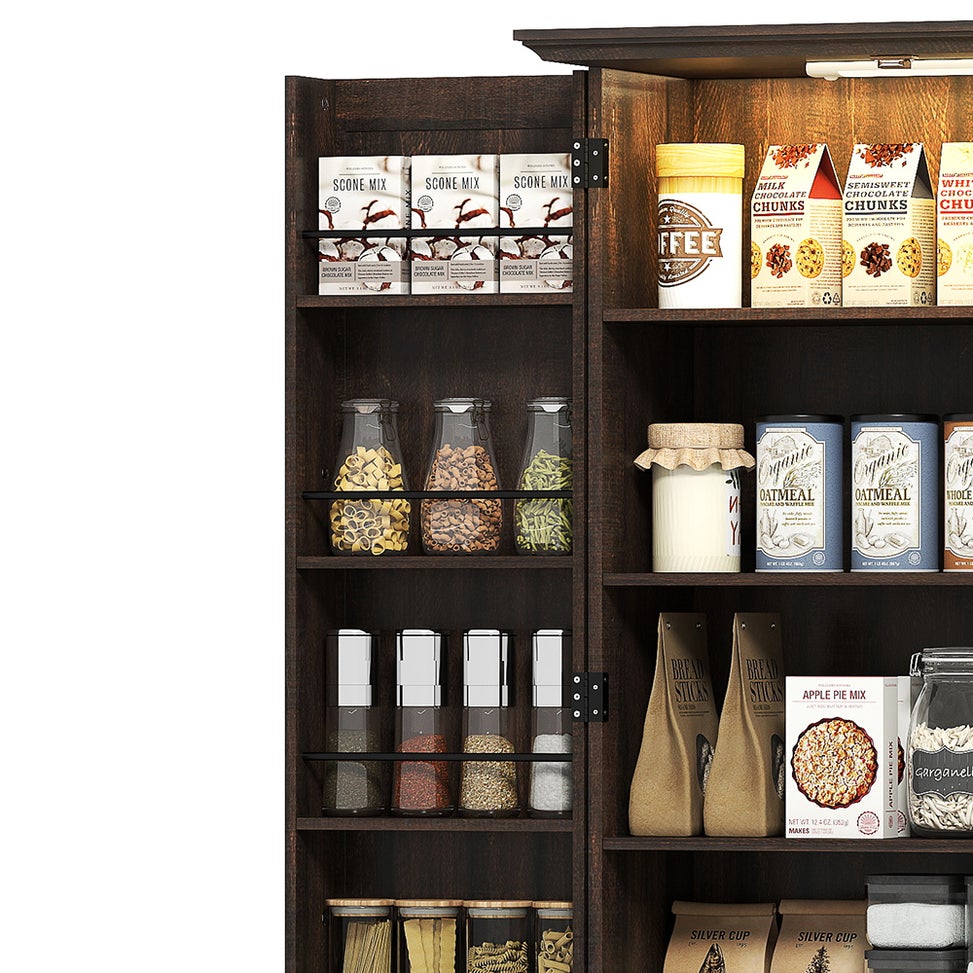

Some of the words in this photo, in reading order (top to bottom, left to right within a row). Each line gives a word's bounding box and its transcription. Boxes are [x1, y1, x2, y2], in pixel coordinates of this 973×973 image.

[333, 178, 364, 191] SCONE
[369, 178, 386, 191] MIX
[426, 177, 458, 190] SCONE
[462, 177, 480, 190] MIX
[514, 176, 546, 189] SCONE
[550, 176, 569, 188] MIX
[757, 182, 785, 190] MILK
[753, 201, 804, 212] CHUNKS
[845, 200, 907, 211] CHUNKS
[658, 231, 717, 255] FFEE
[759, 443, 812, 486] Organic
[854, 442, 909, 486] Organic
[760, 489, 815, 501] OATMEAL
[855, 488, 911, 501] OATMEAL
[671, 659, 704, 680] BREAD
[746, 659, 778, 680] BREAD
[675, 681, 708, 703] STICKS
[750, 681, 784, 703] STICKS
[803, 690, 830, 700] APPLE
[834, 690, 847, 700] PIE
[850, 690, 866, 700] MIX
[691, 930, 725, 940] SILVER
[729, 931, 750, 940] CUP
[798, 932, 833, 942] SILVER
[836, 933, 857, 942] CUP
